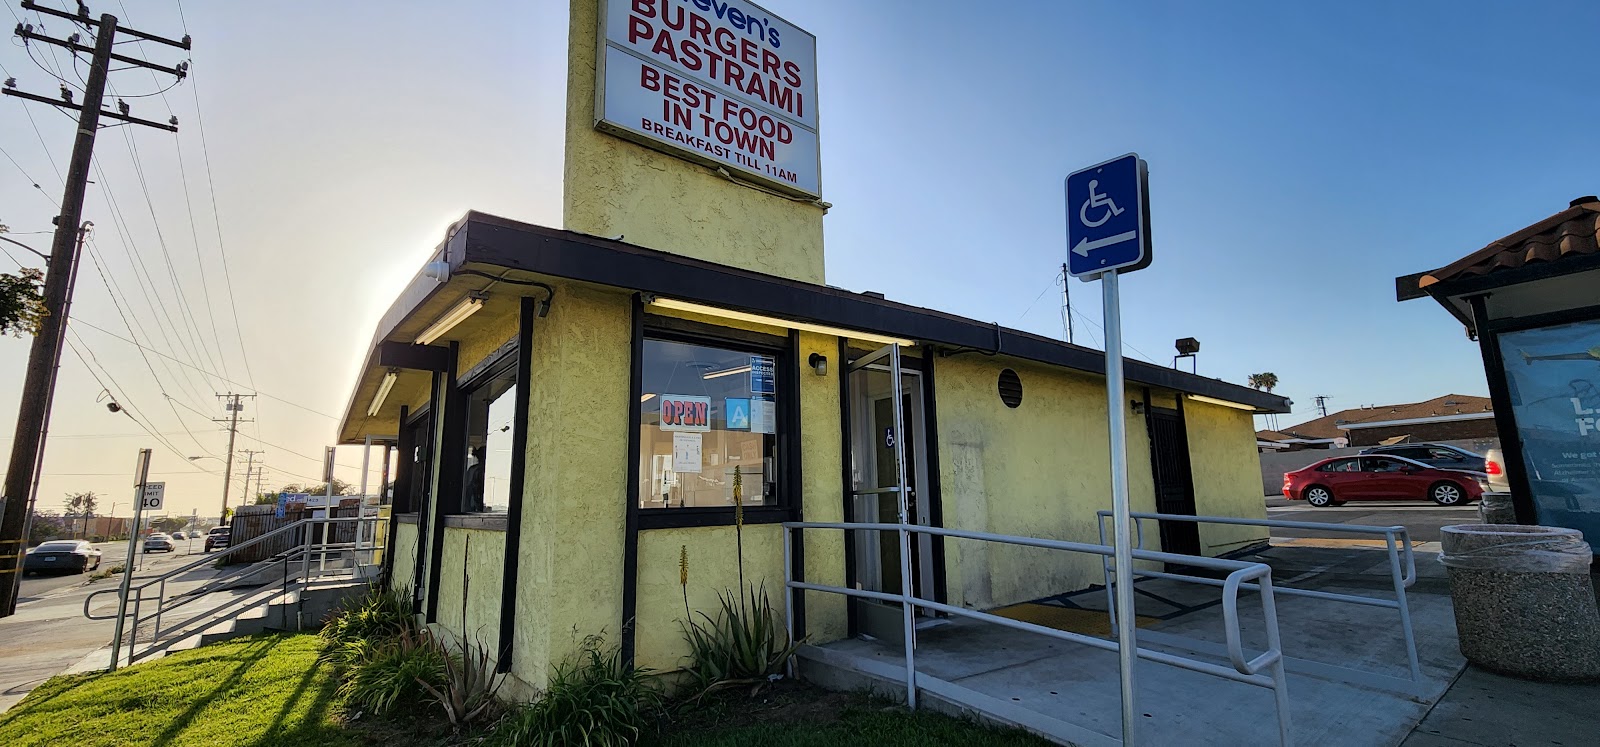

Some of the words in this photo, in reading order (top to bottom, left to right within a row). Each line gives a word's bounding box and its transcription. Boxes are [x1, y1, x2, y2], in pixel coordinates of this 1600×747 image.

[628, 14, 803, 118] PASTRAMI
[631, 0, 802, 88] BURGERS
[640, 64, 716, 114] BEST
[723, 98, 793, 145] FOOD
[663, 99, 692, 131] IN
[699, 114, 775, 161] TOWN
[641, 117, 731, 160] BREAKFAST
[735, 152, 761, 171] TILL
[765, 164, 797, 184] 11AM
[663, 399, 709, 427] OPEN
[732, 405, 745, 423] A
[1580, 451, 1597, 460] got
